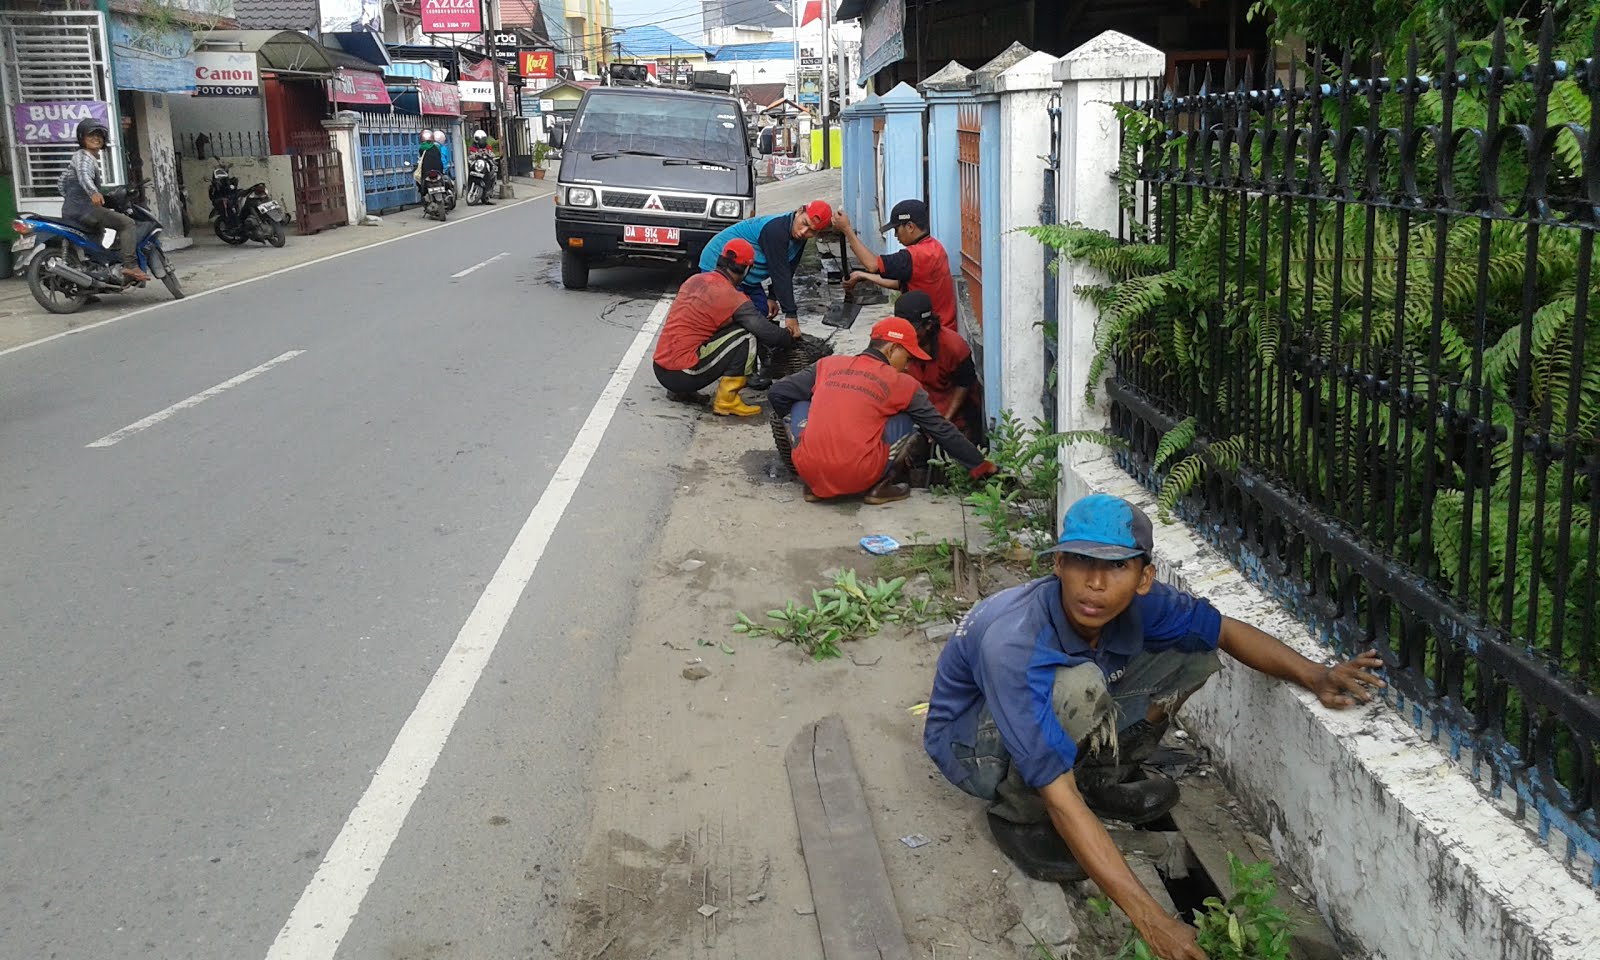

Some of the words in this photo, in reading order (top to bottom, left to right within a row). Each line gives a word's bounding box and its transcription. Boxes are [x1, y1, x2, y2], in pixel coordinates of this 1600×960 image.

[195, 66, 253, 81] Canon
[198, 86, 223, 95] FOTO
[226, 87, 254, 95] COPY
[29, 104, 93, 121] BUKA
[24, 123, 52, 140] 24
[625, 226, 636, 237] DA
[644, 228, 658, 238] 914
[666, 229, 679, 240] AH
